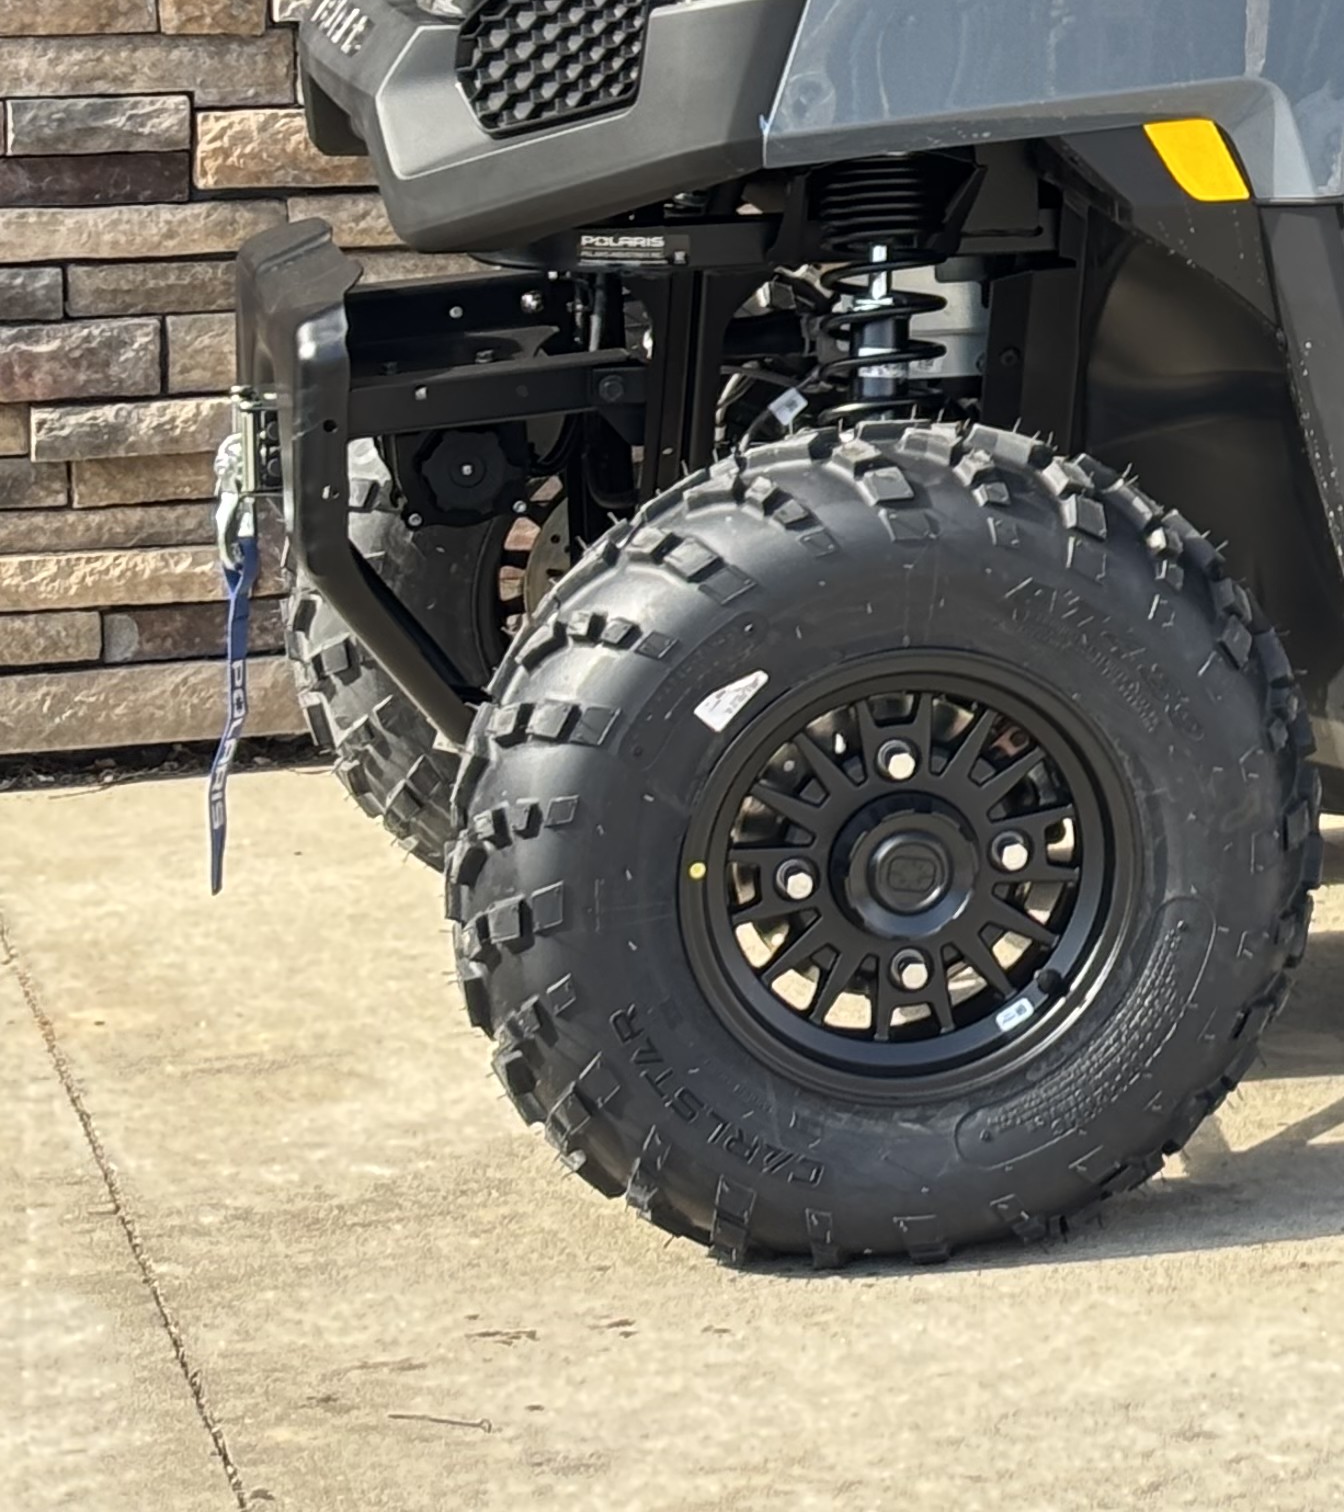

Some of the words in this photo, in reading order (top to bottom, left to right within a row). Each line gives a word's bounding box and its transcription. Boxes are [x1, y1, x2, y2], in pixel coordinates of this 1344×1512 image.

[581, 235, 665, 248] POLARIS
[211, 659, 247, 830] POLARIS
[608, 1002, 825, 1187] CARLSTAR
